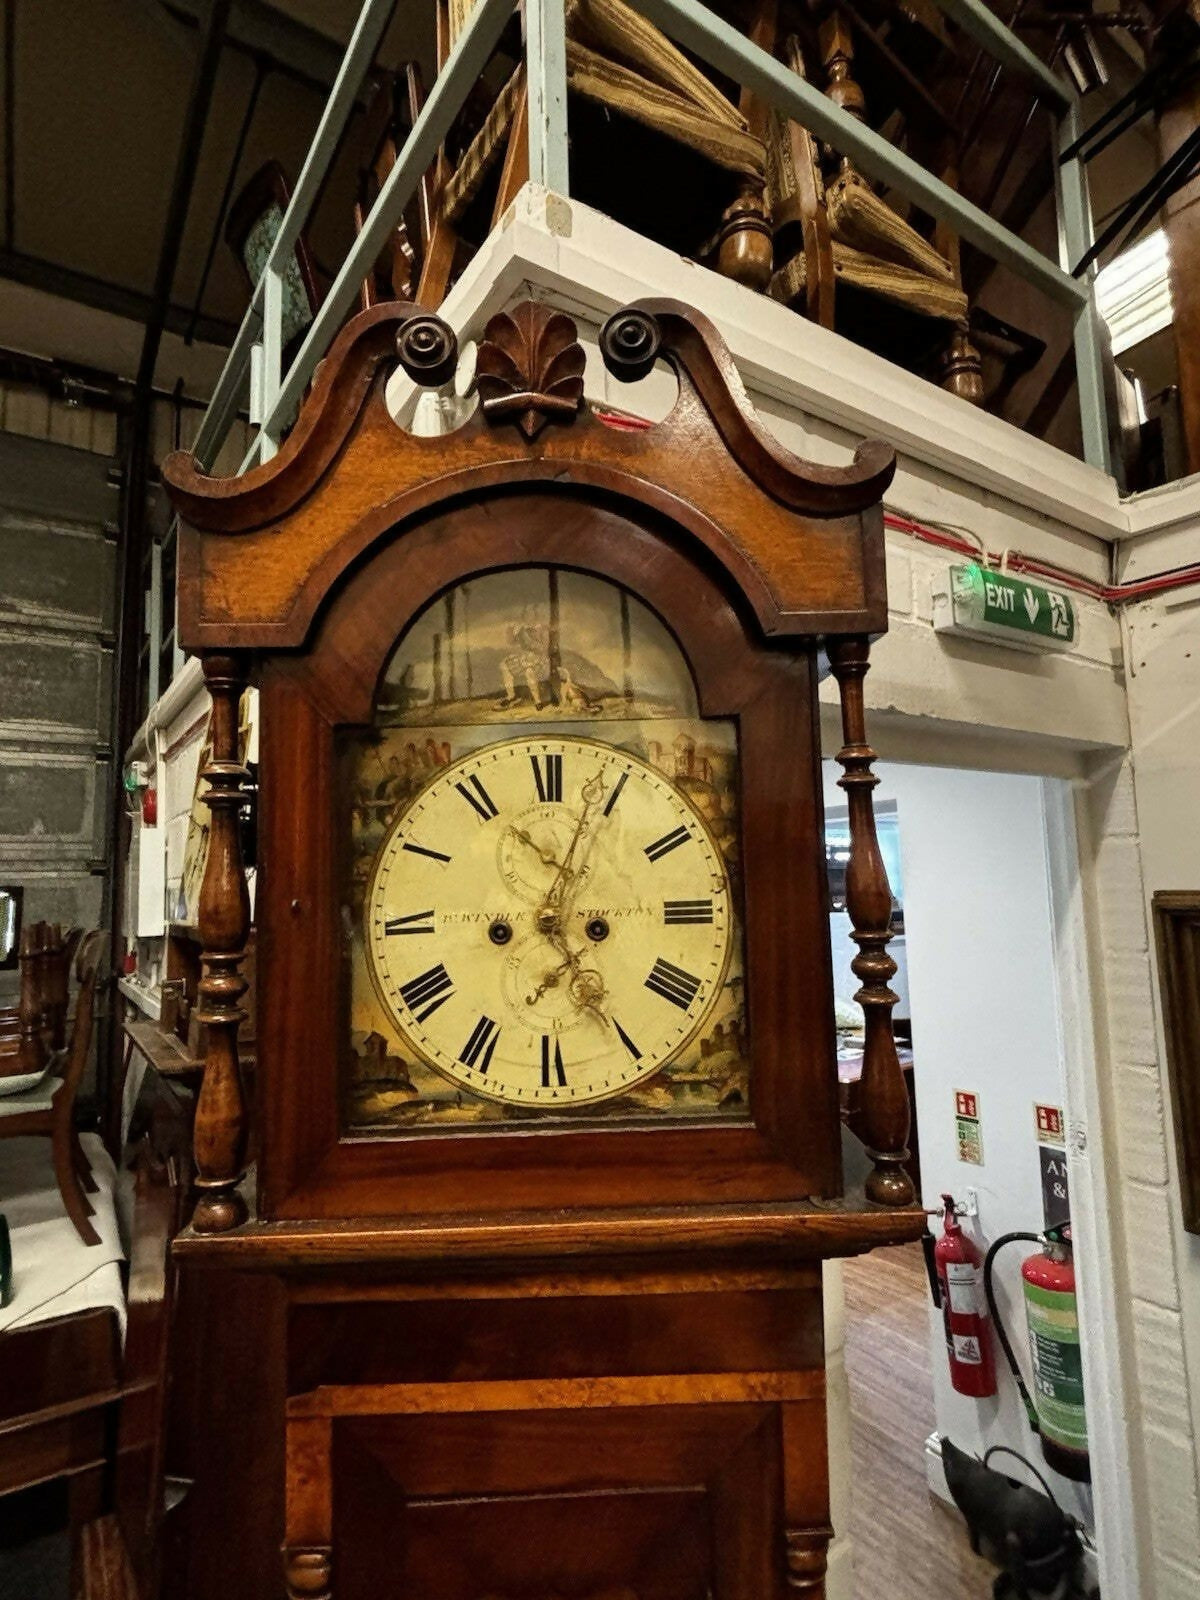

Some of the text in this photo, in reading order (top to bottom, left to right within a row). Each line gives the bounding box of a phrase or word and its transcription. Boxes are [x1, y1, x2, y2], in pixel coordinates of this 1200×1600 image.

[985, 582, 1015, 612] EXIT
[642, 824, 693, 864] II
[663, 898, 714, 925] III
[1053, 1182, 1066, 1199] &
